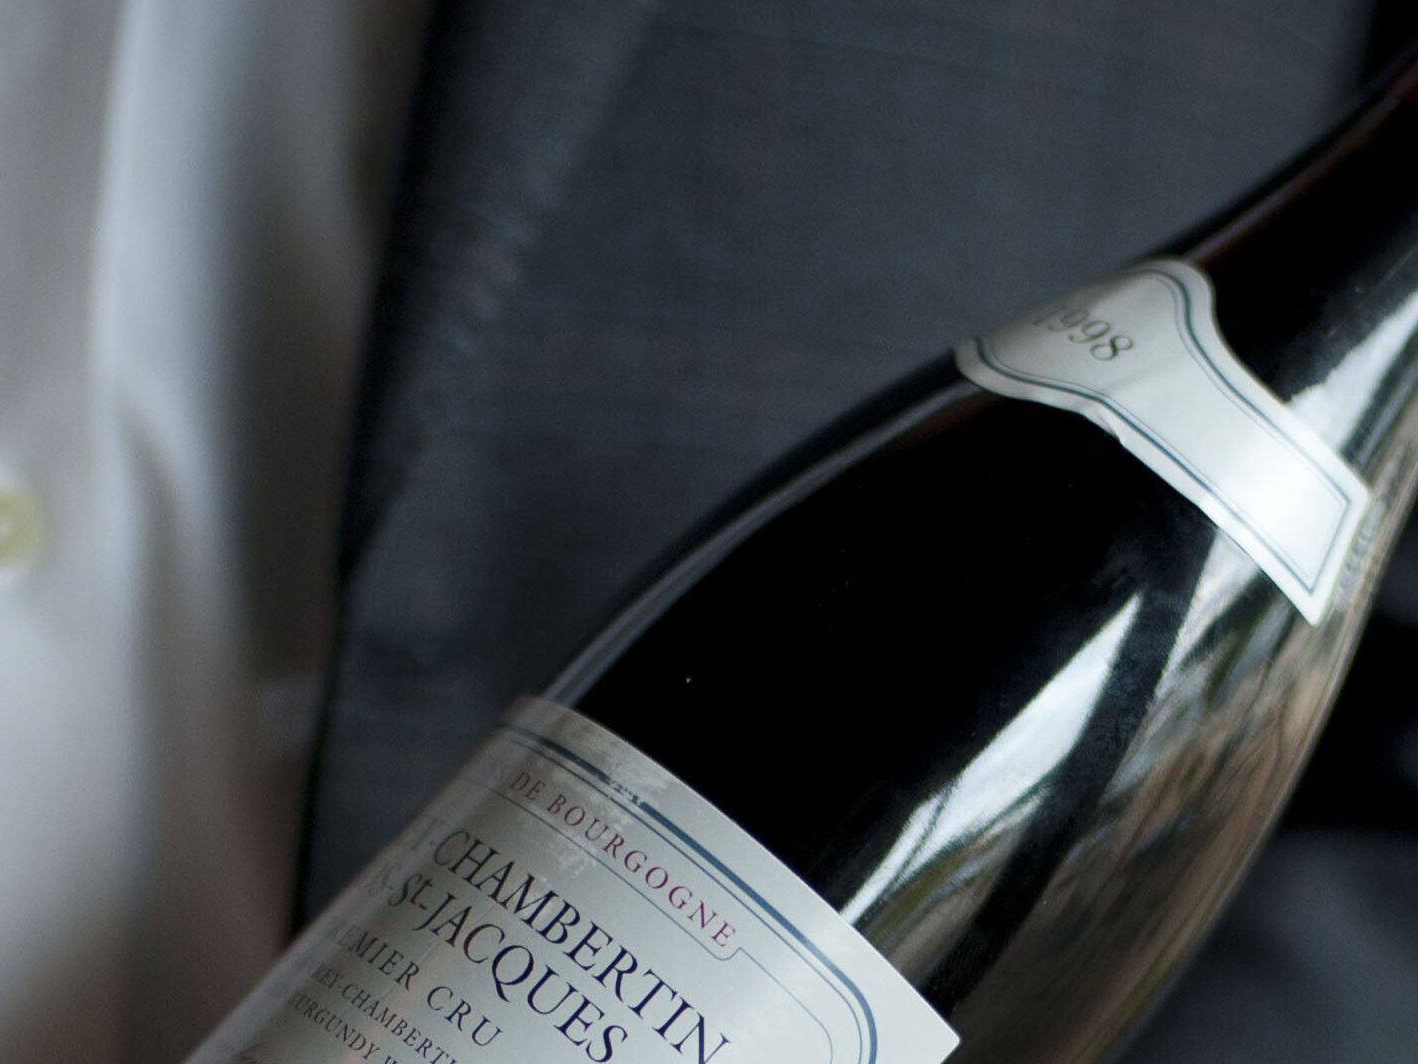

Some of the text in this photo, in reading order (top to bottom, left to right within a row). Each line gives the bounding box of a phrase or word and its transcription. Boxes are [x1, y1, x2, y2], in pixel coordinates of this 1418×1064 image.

[509, 771, 545, 802] DE
[547, 794, 736, 947] BOURGOGNE
[427, 985, 504, 1047] CRU
